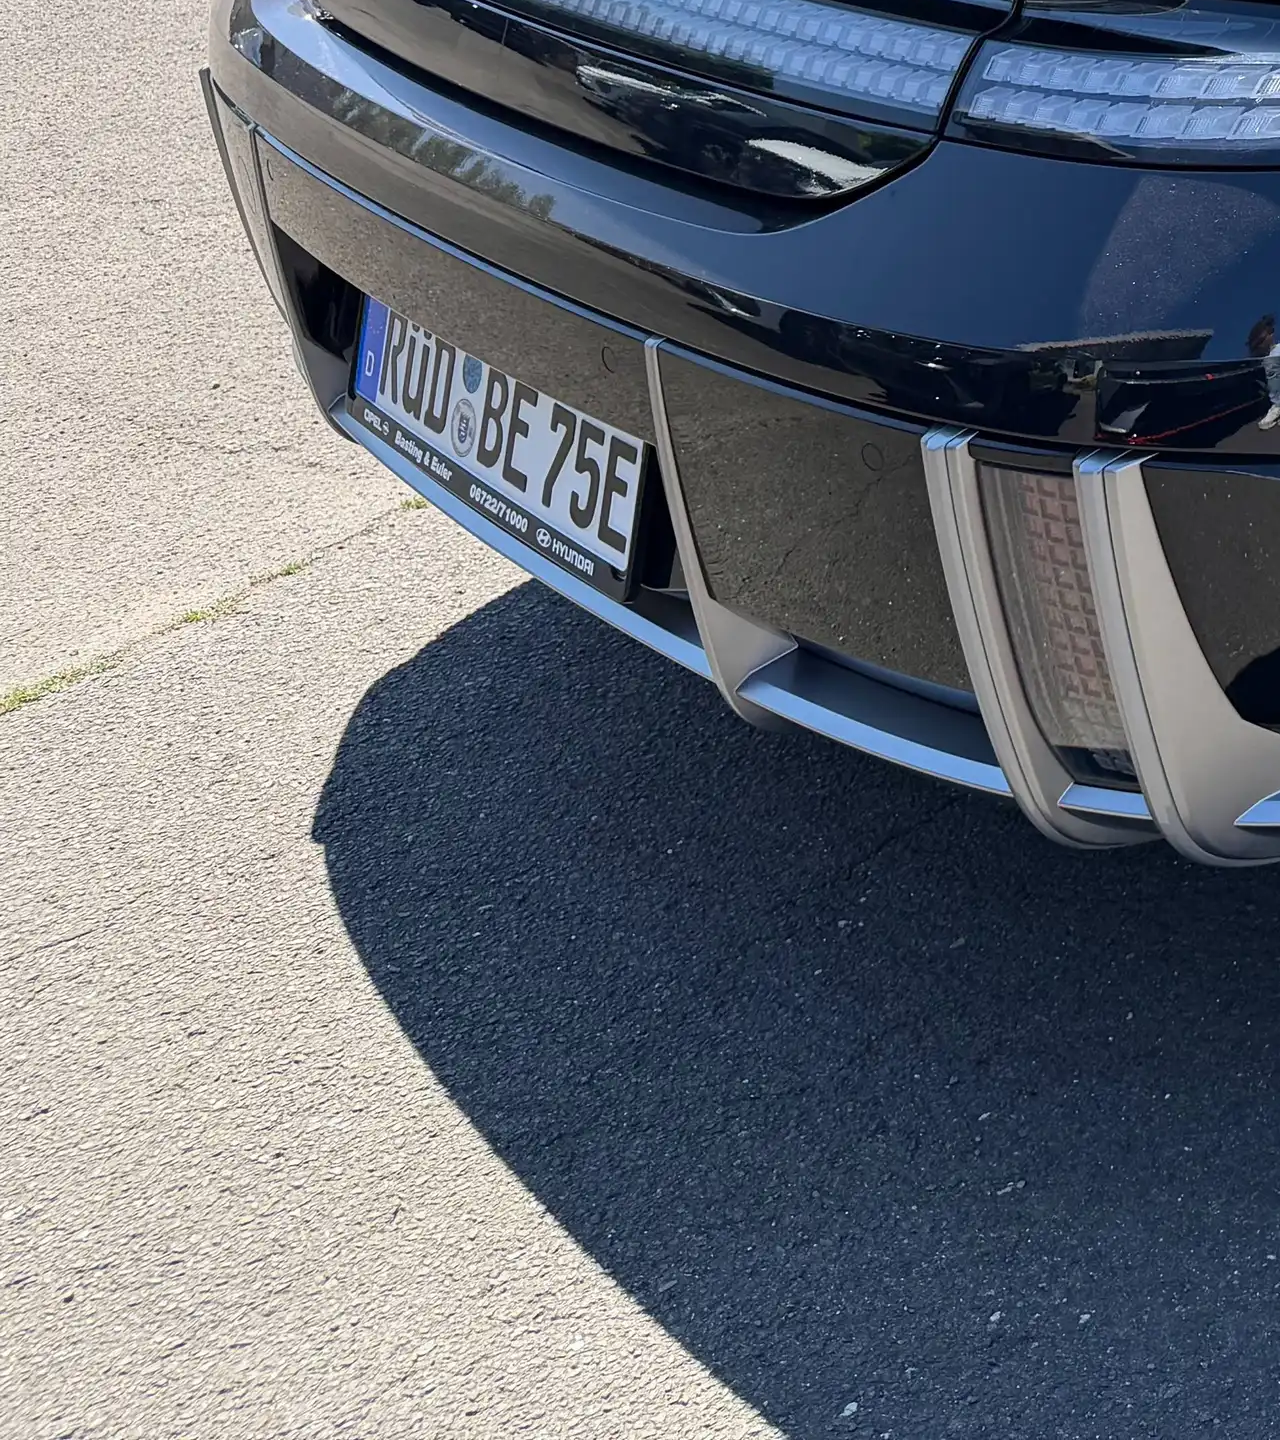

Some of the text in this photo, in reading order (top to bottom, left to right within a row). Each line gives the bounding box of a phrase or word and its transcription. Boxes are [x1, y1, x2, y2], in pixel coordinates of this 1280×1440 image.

[364, 350, 376, 377] D
[379, 311, 456, 435] RÜD
[476, 366, 539, 493] BE
[541, 403, 638, 554] 75E
[364, 408, 382, 432] OPEL
[394, 430, 423, 463] Basting
[430, 456, 453, 481] Euler
[552, 538, 595, 576] HYUNDAI
